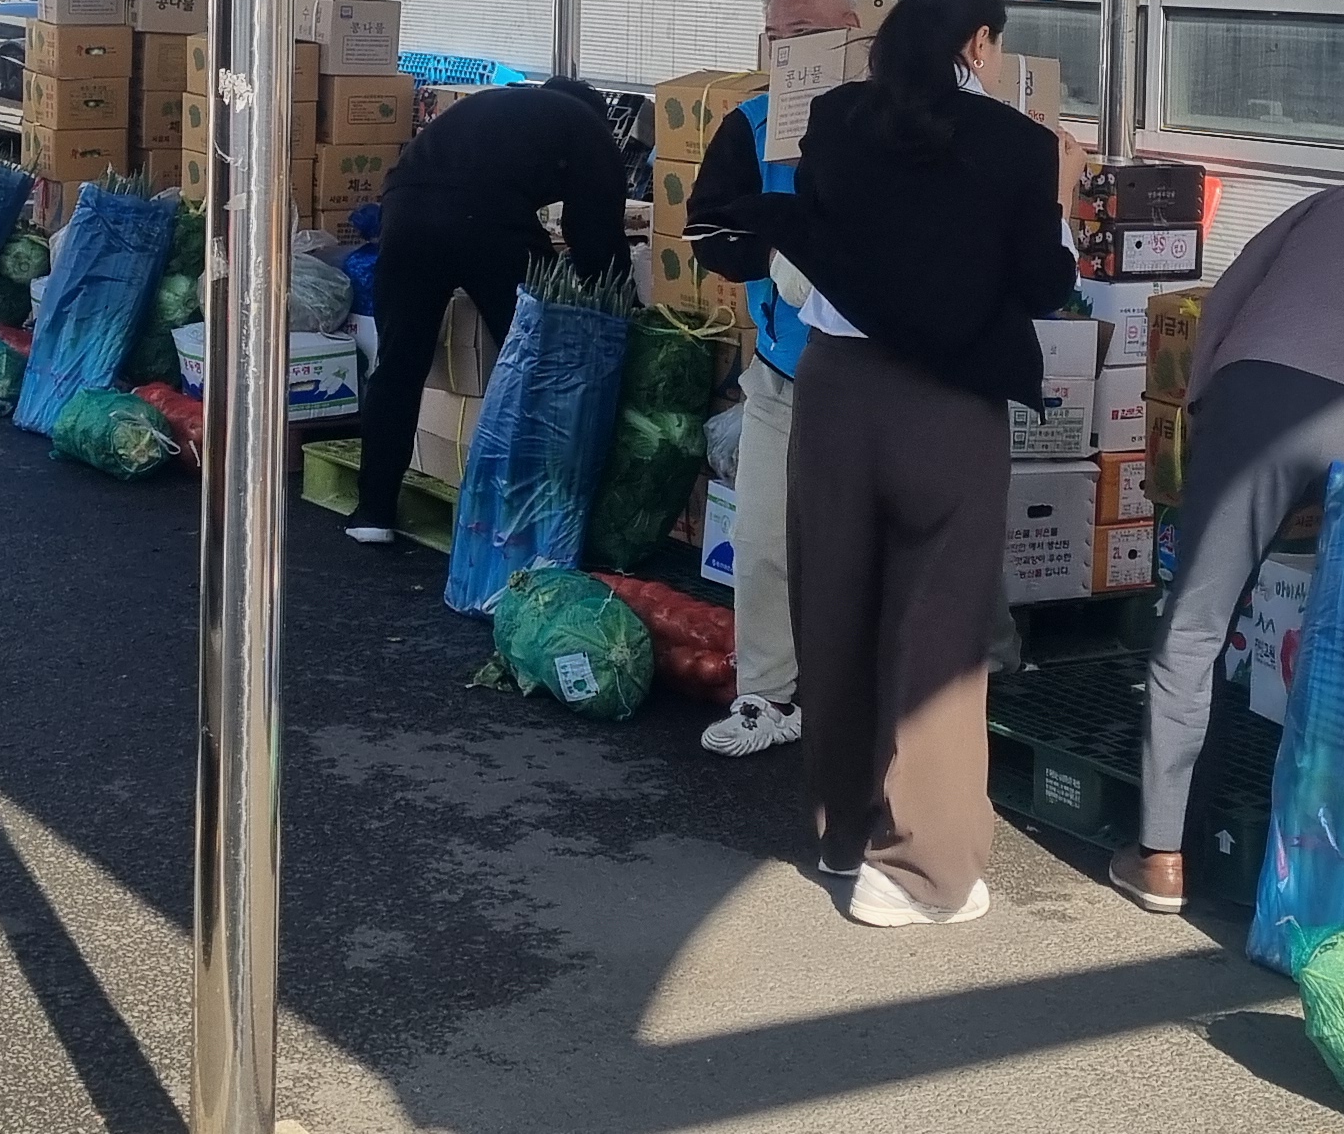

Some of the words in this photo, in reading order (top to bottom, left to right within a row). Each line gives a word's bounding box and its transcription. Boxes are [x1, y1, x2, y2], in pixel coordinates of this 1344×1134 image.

[350, 21, 385, 35] 콩나물
[785, 65, 822, 89] 콩나물
[1152, 316, 1188, 340] 시금치
